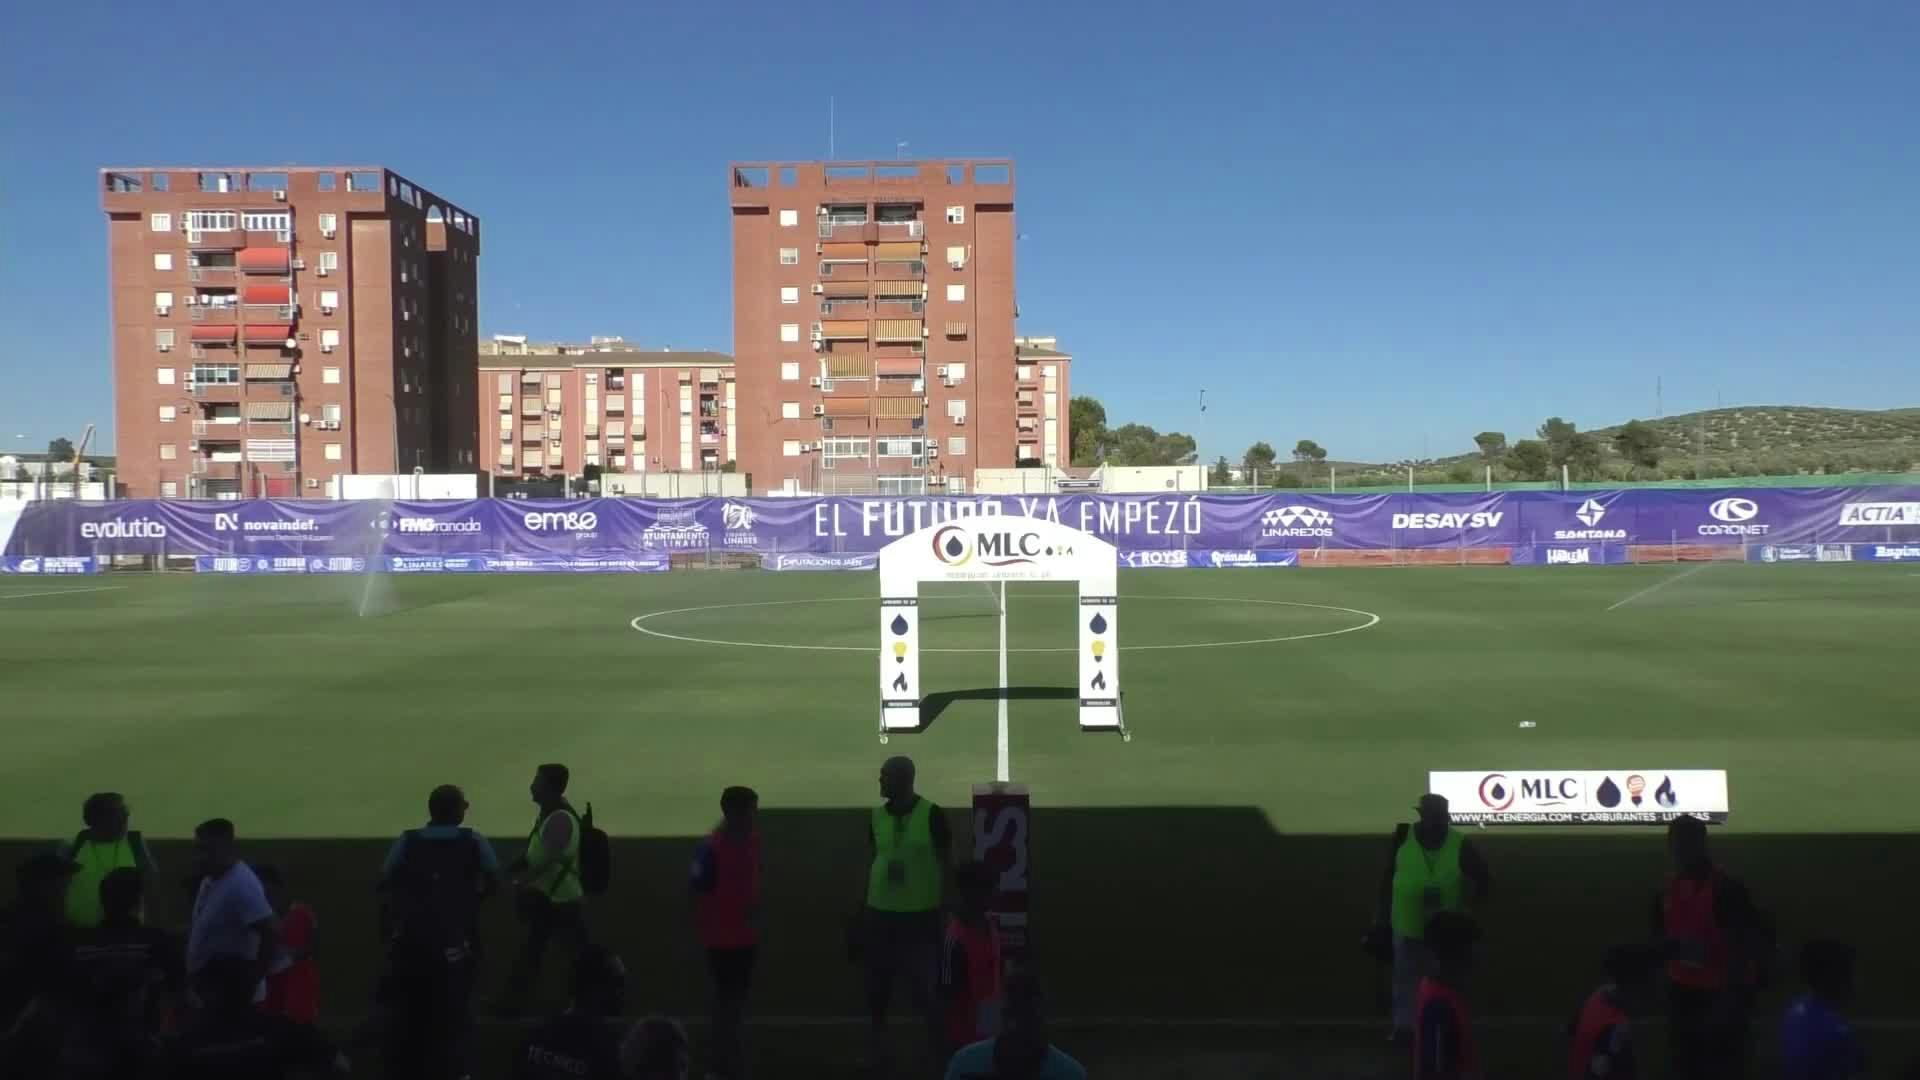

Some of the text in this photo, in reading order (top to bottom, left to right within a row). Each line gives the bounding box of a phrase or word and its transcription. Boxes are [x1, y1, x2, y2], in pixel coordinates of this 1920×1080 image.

[816, 503, 847, 536] EL
[1081, 495, 1201, 534] EMPEZÓ
[1392, 511, 1504, 529] DESAY SV
[1848, 507, 1904, 521] ACTIA
[81, 516, 166, 539] evolutio
[1262, 528, 1333, 537] LINAREJOS
[1698, 524, 1770, 535] CORONET
[643, 531, 709, 541] AYUNTAMIENTO
[1554, 529, 1626, 539] SANTANA
[723, 537, 758, 545] LINARES
[978, 533, 1041, 557] MLC
[1142, 551, 1187, 563] ROYSE
[1521, 778, 1578, 799] MLC
[1450, 813, 1572, 823] WWW.MLCENERGIA.COM
[1581, 812, 1657, 822] CARBURANTES
